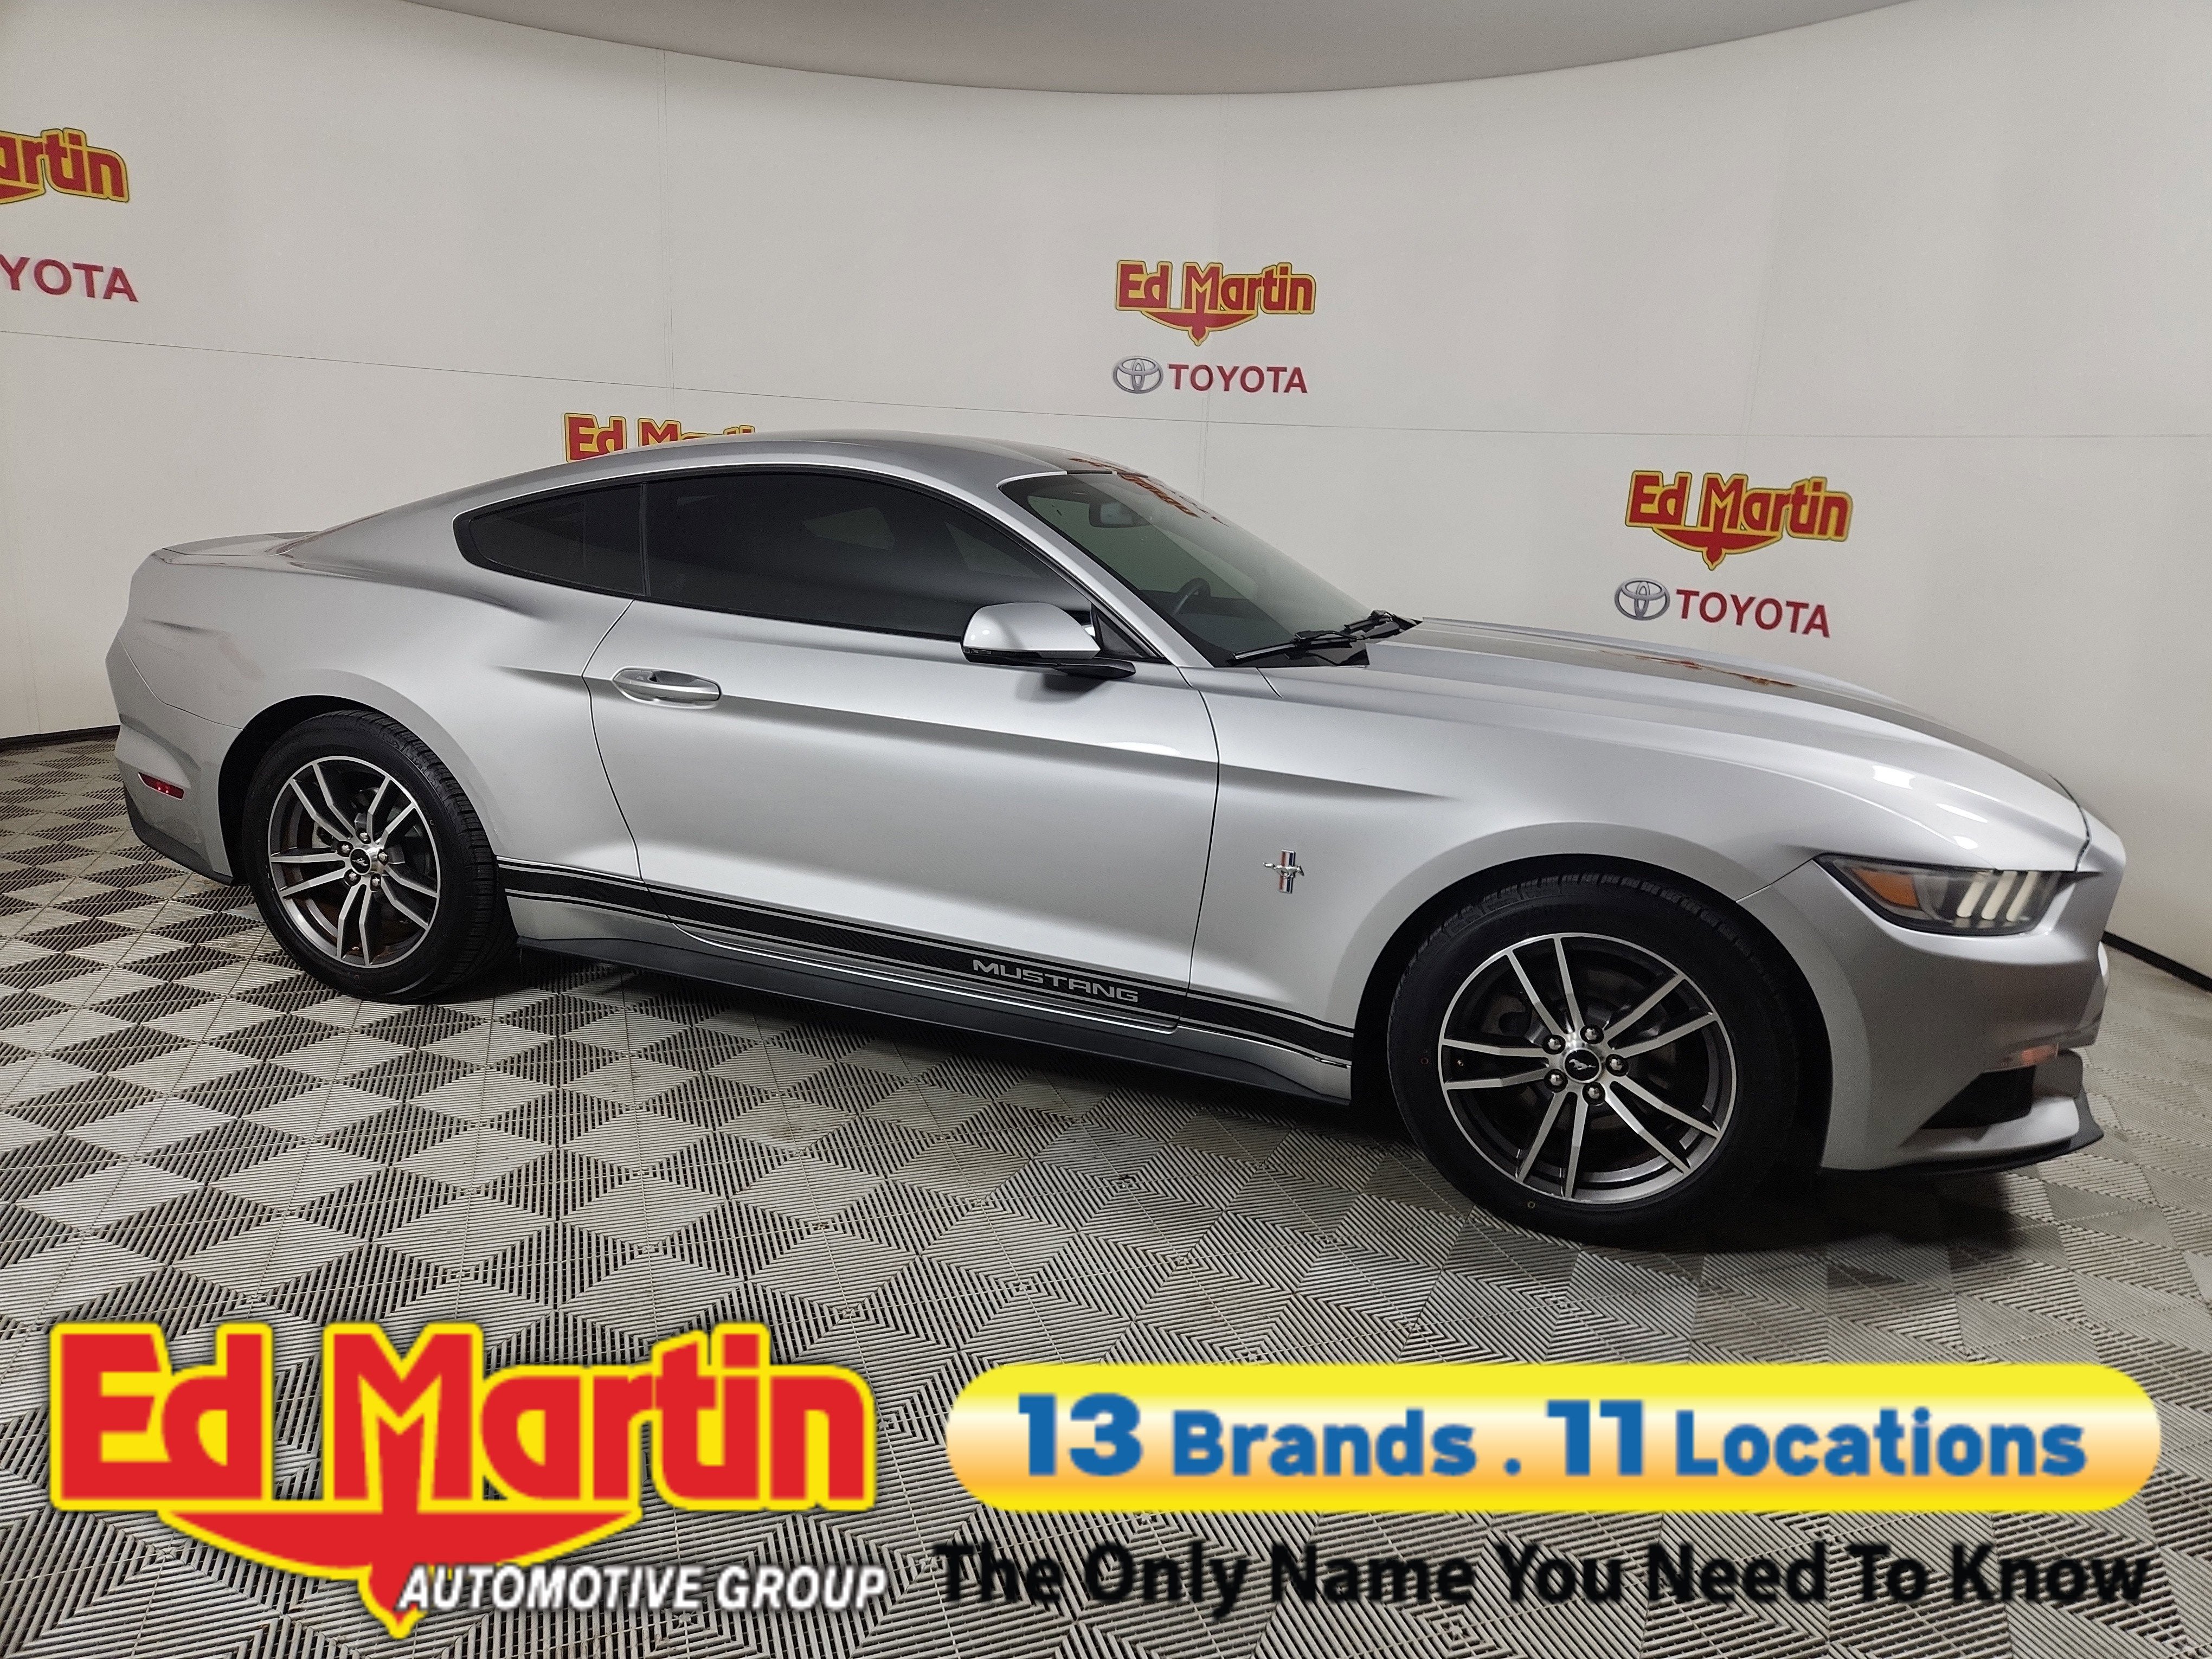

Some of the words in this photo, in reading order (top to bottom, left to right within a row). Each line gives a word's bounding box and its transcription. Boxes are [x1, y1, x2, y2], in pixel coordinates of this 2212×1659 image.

[0, 128, 128, 202] artin
[0, 254, 139, 303] YOTA
[1117, 261, 1172, 310] Ed
[1182, 262, 1316, 314] Martin
[1167, 363, 1308, 394] TOYOTA
[565, 413, 626, 462] Ed
[1626, 471, 1692, 527] Ed
[1701, 472, 1853, 541] Martin
[1676, 588, 1830, 638] TOYOTA
[973, 959, 1139, 1002] MUSTANG
